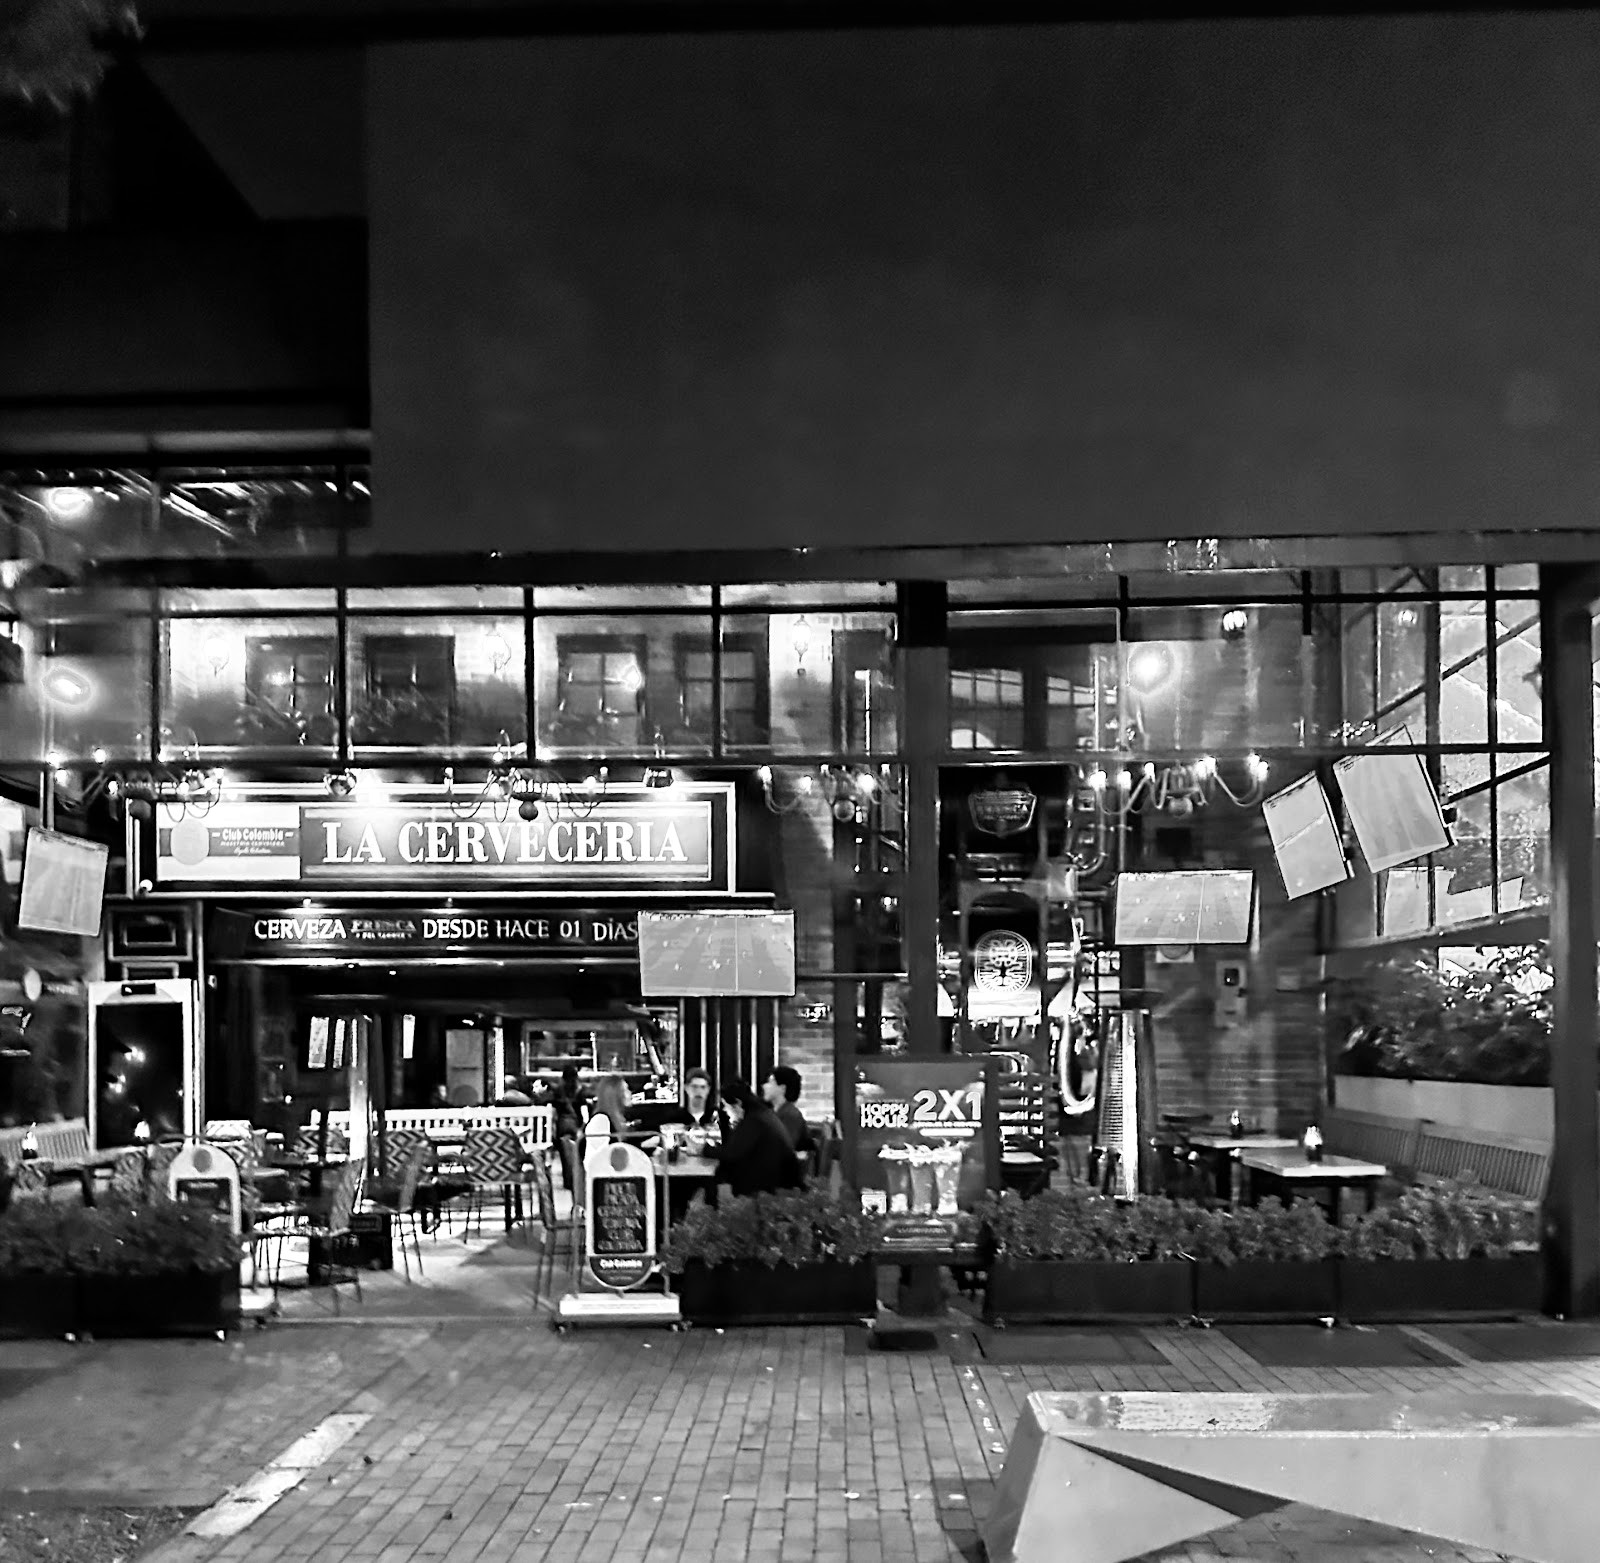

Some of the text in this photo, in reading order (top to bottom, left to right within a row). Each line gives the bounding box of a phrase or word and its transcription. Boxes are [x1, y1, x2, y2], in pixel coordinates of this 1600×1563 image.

[222, 828, 284, 841] Club Colombia
[322, 821, 688, 863] LA CERVECERIA
[254, 919, 347, 940] CERVEZA
[422, 919, 489, 939] DESDE
[496, 919, 550, 939] HACE
[860, 1114, 909, 1128] HOUR
